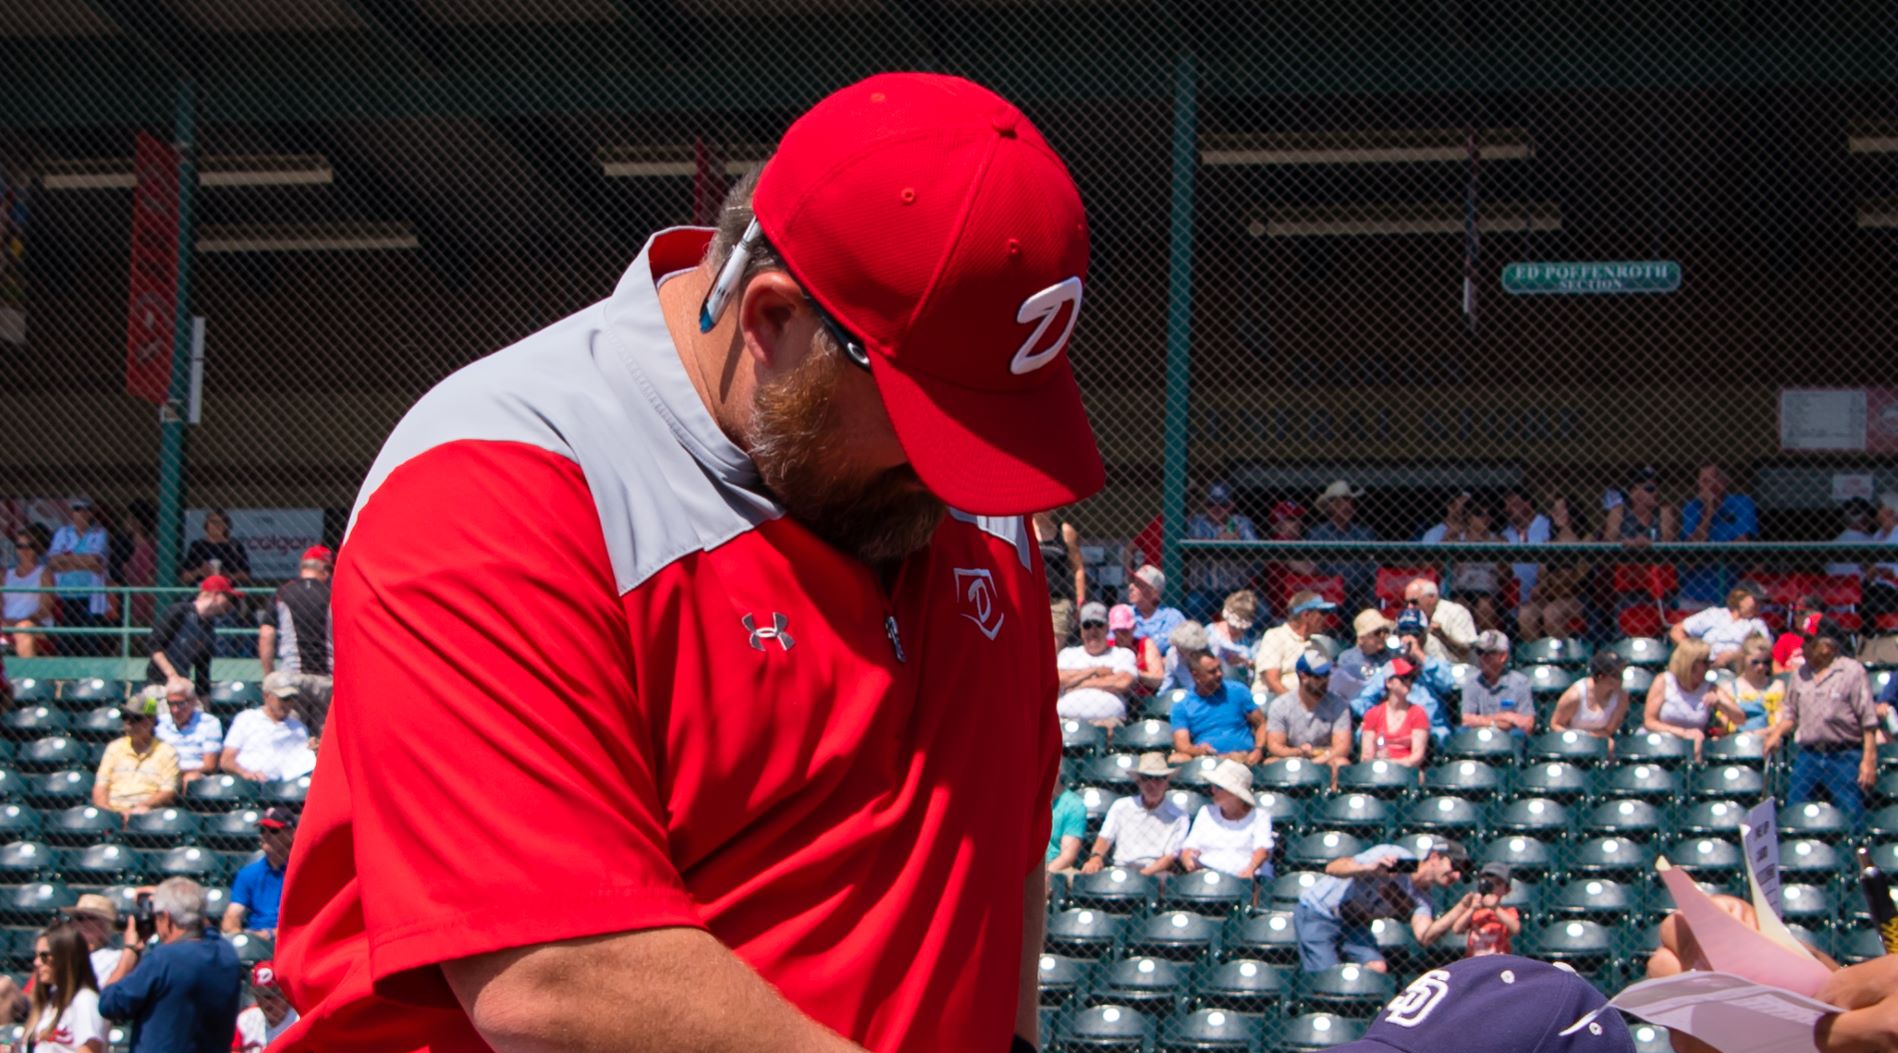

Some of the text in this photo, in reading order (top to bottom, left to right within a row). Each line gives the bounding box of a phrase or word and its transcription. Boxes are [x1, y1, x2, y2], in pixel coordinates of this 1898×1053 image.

[1515, 264, 1669, 279] ED POFFENROTH
[1559, 279, 1623, 290] SECTION
[1010, 275, 1083, 374] D
[1190, 405, 1392, 442] ENERAL
[1384, 968, 1451, 1028] SD
